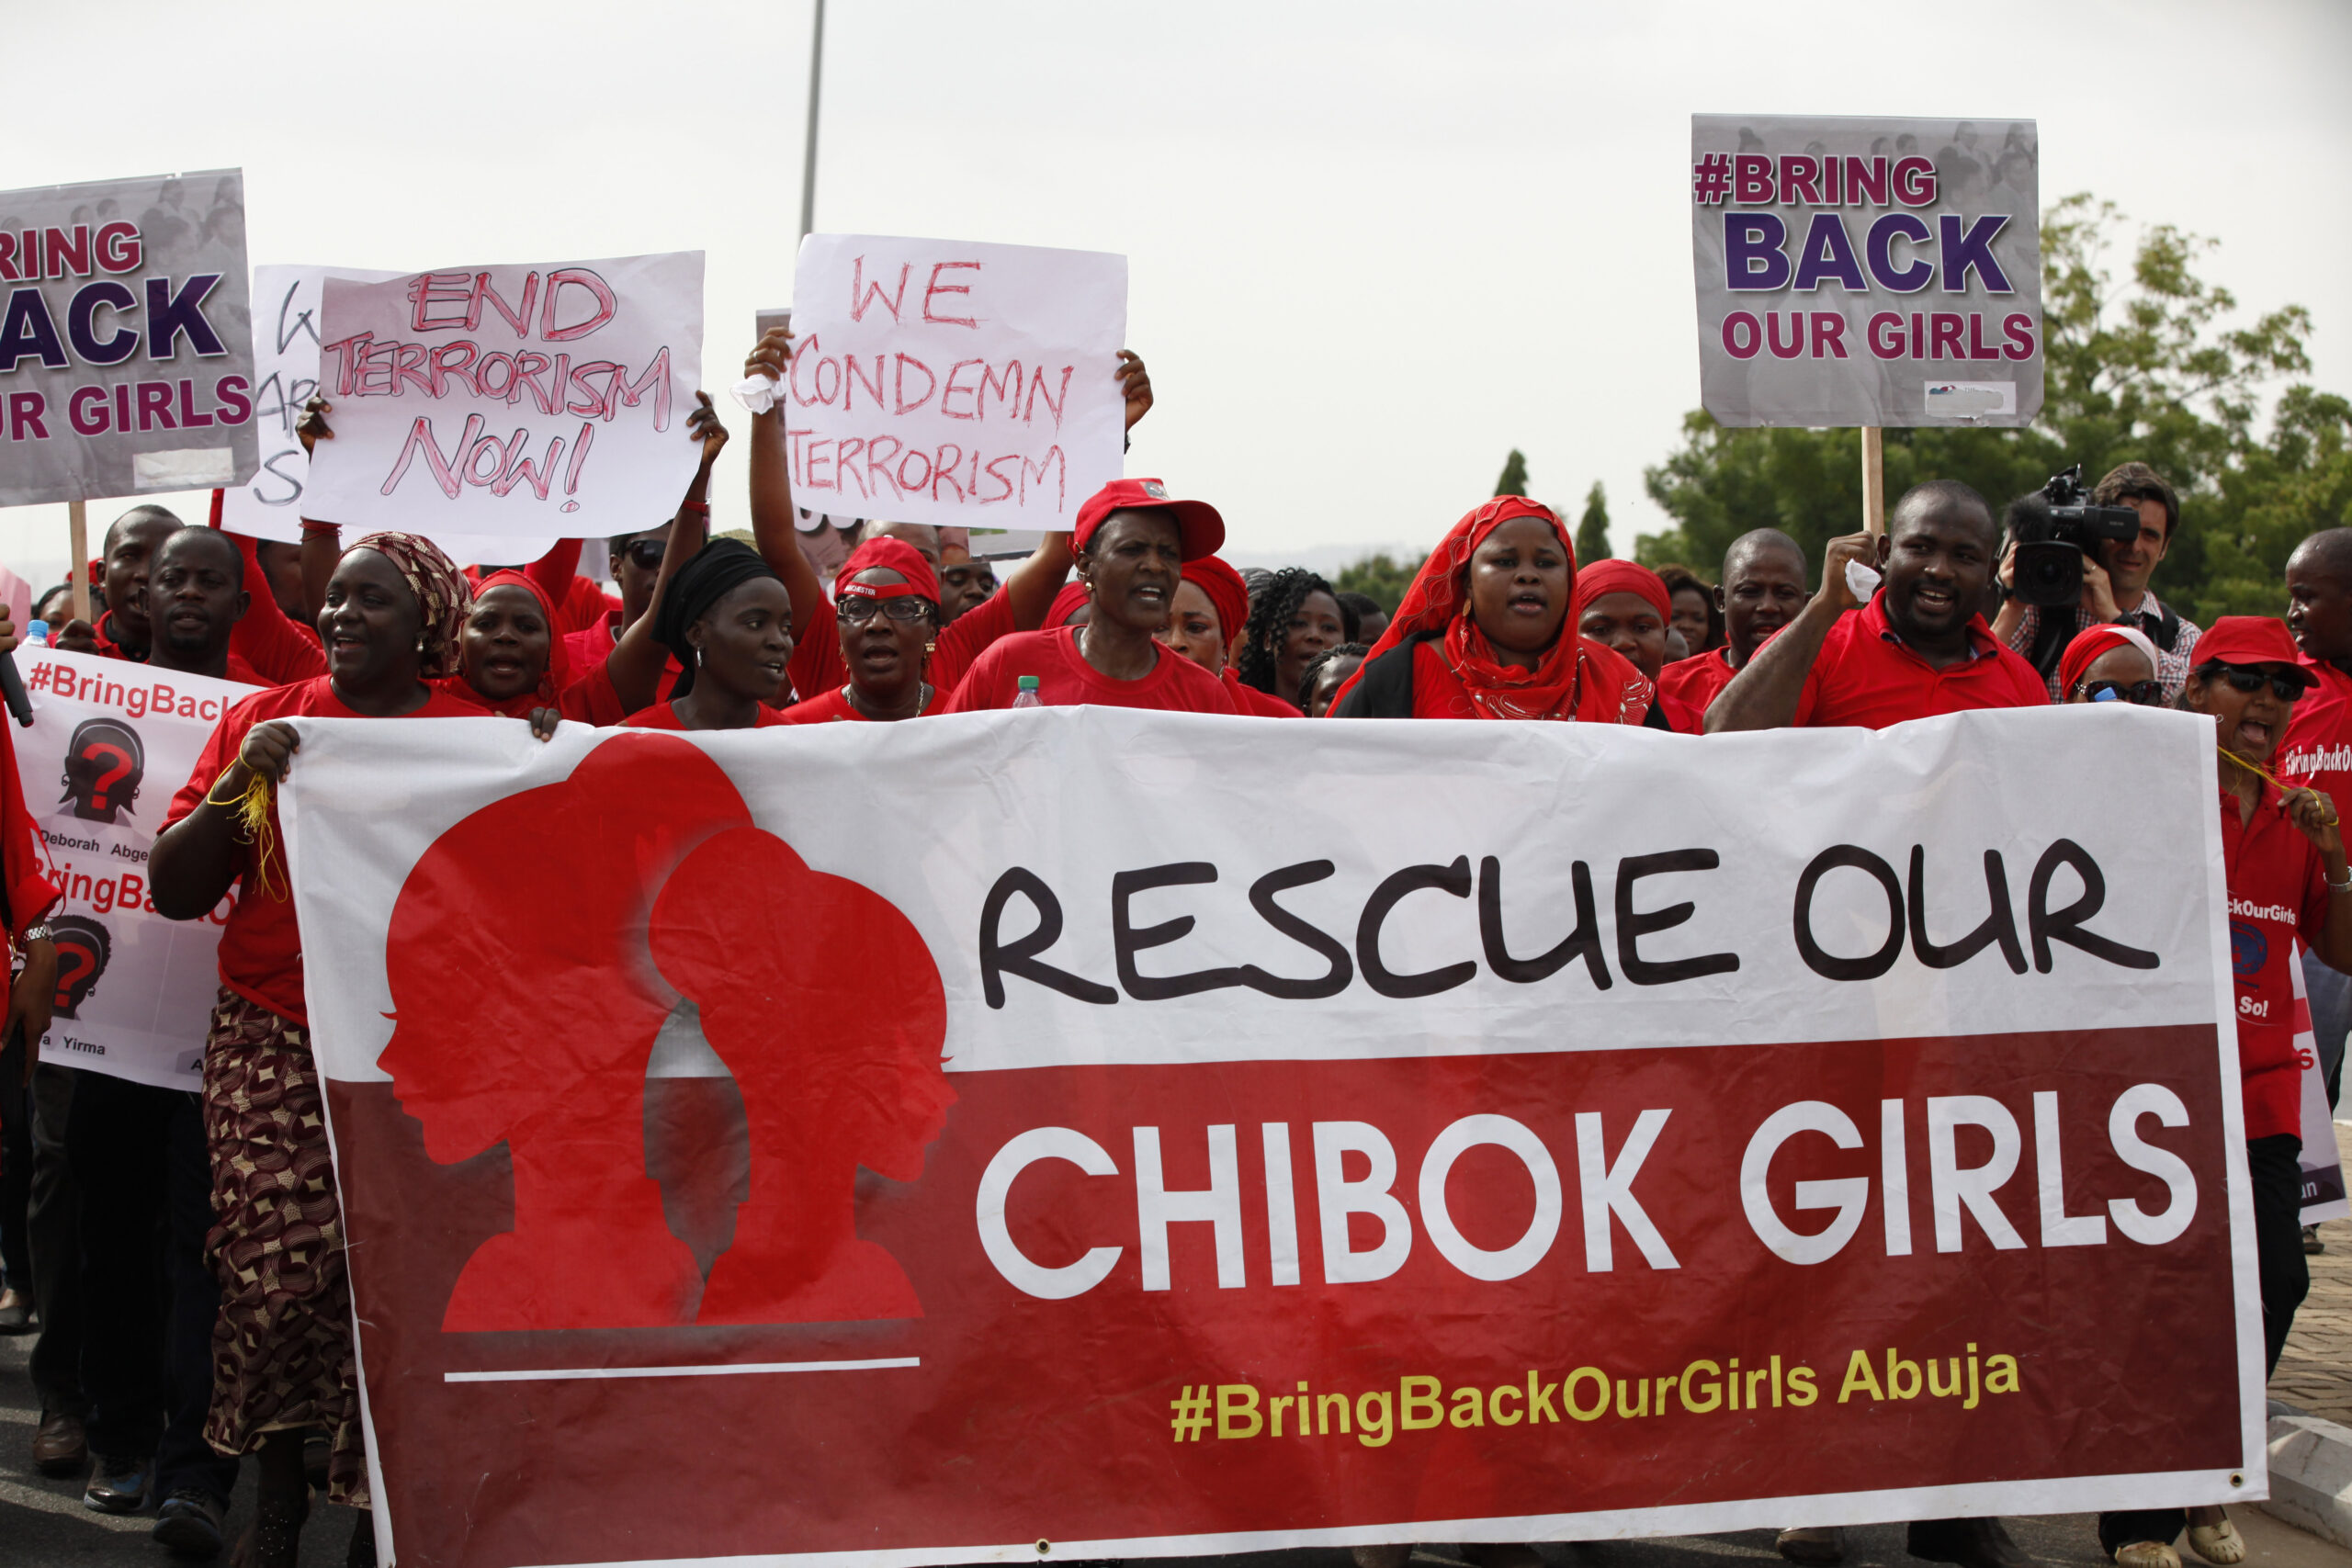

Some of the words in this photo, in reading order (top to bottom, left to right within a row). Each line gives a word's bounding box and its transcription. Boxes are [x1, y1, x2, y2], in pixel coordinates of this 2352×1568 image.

[1692, 152, 1938, 208] #BRING
[850, 254, 989, 329] WE
[1723, 211, 2016, 294] BACK
[408, 267, 617, 342] END
[1721, 310, 1850, 360] OUR
[1866, 310, 2036, 361] GIRLS
[0, 389, 51, 442] R
[68, 374, 253, 437] GIRLS
[324, 332, 671, 433] TERRORISM
[789, 333, 1075, 434] CONDEMN
[381, 413, 595, 513] NOW!
[787, 428, 1066, 514] TERRORISM
[40, 829, 100, 852] Deborah
[979, 848, 1741, 1010] RESCUE
[1792, 838, 2161, 982] OUR
[63, 1036, 106, 1055] Yirma
[2239, 996, 2269, 1018] So!
[976, 1108, 1681, 1301] CHIBOK
[1739, 1083, 2199, 1266] GIRLS
[1170, 1355, 1818, 1449] #BringBackOurGirls
[1837, 1342, 2021, 1410] Abuja
